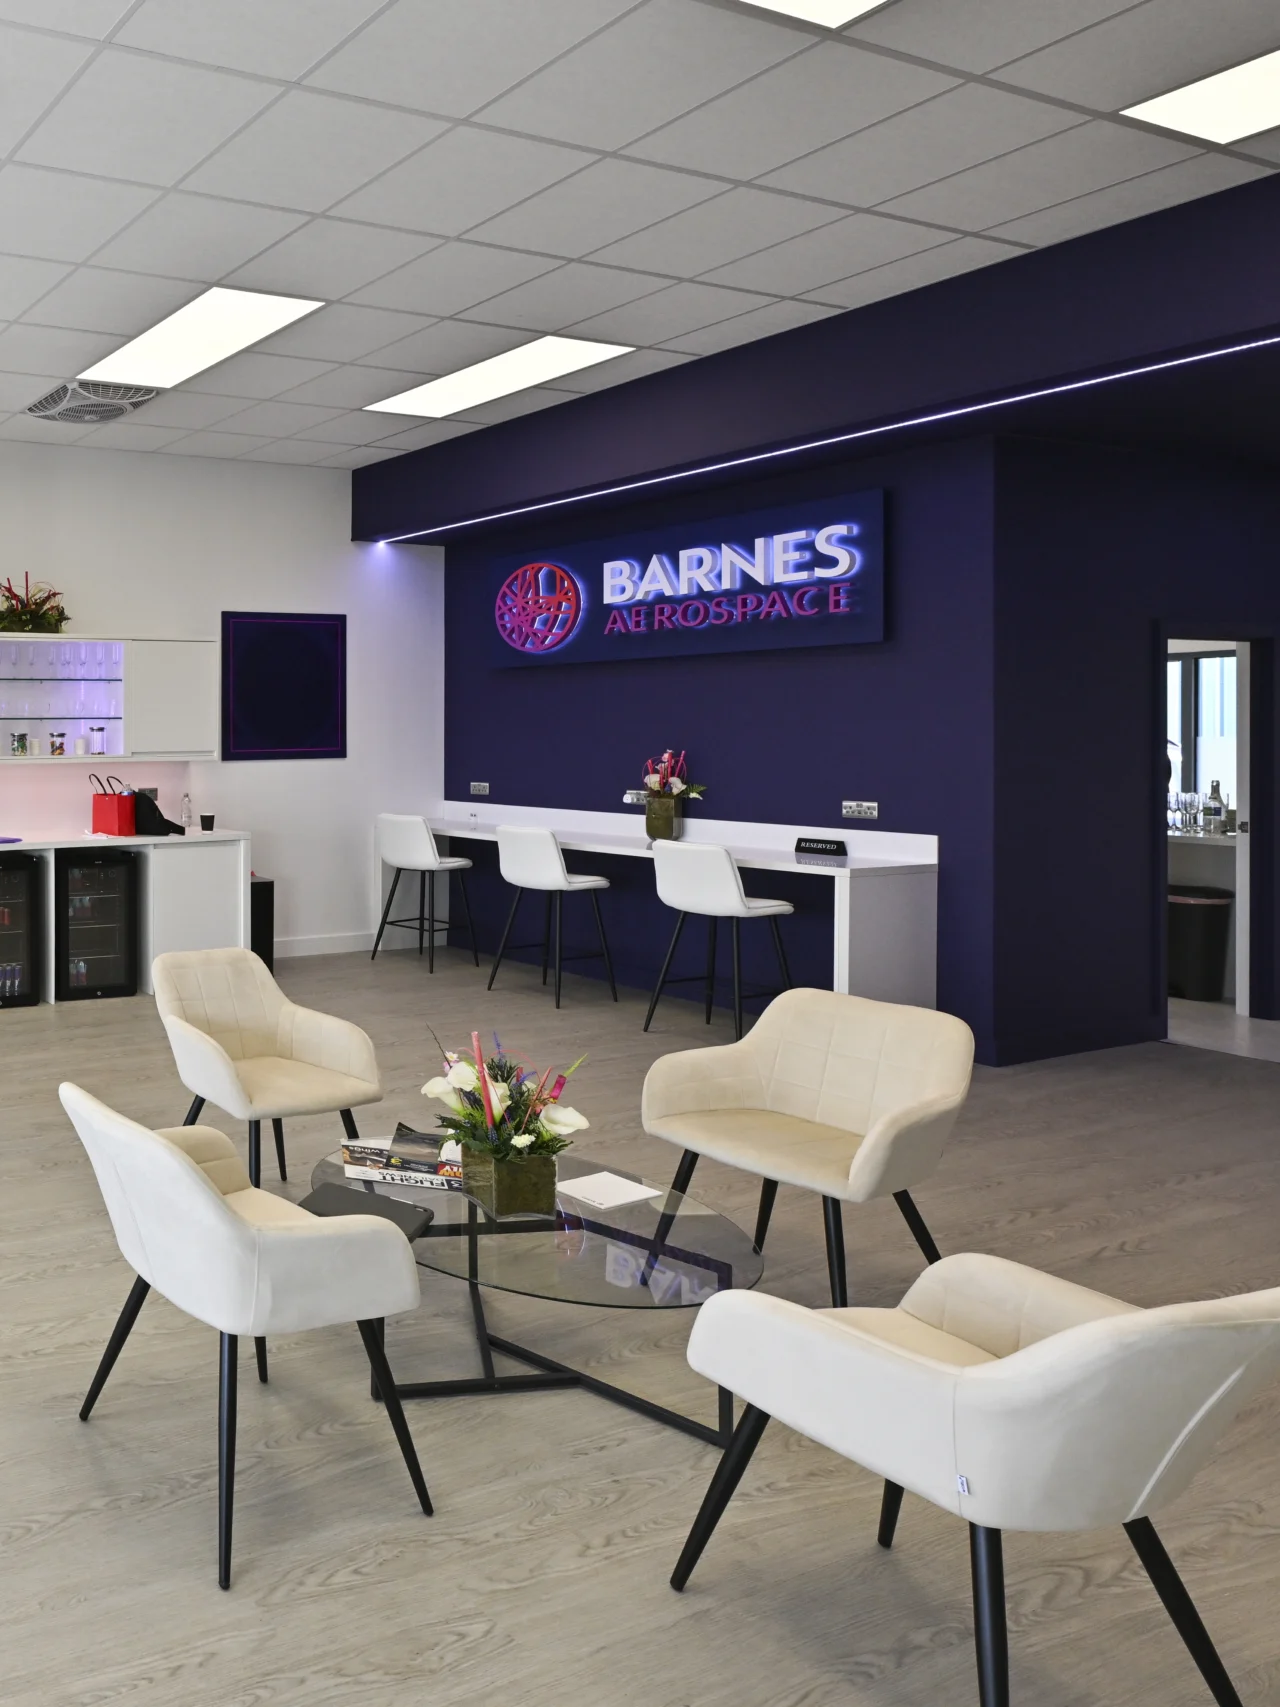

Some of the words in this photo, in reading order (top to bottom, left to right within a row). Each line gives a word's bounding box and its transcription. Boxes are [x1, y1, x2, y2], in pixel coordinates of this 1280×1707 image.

[603, 523, 859, 604] BARNES
[604, 582, 853, 635] AEROSPACE
[800, 841, 837, 850] RESERVED
[379, 1174, 446, 1187] FLIGHT
